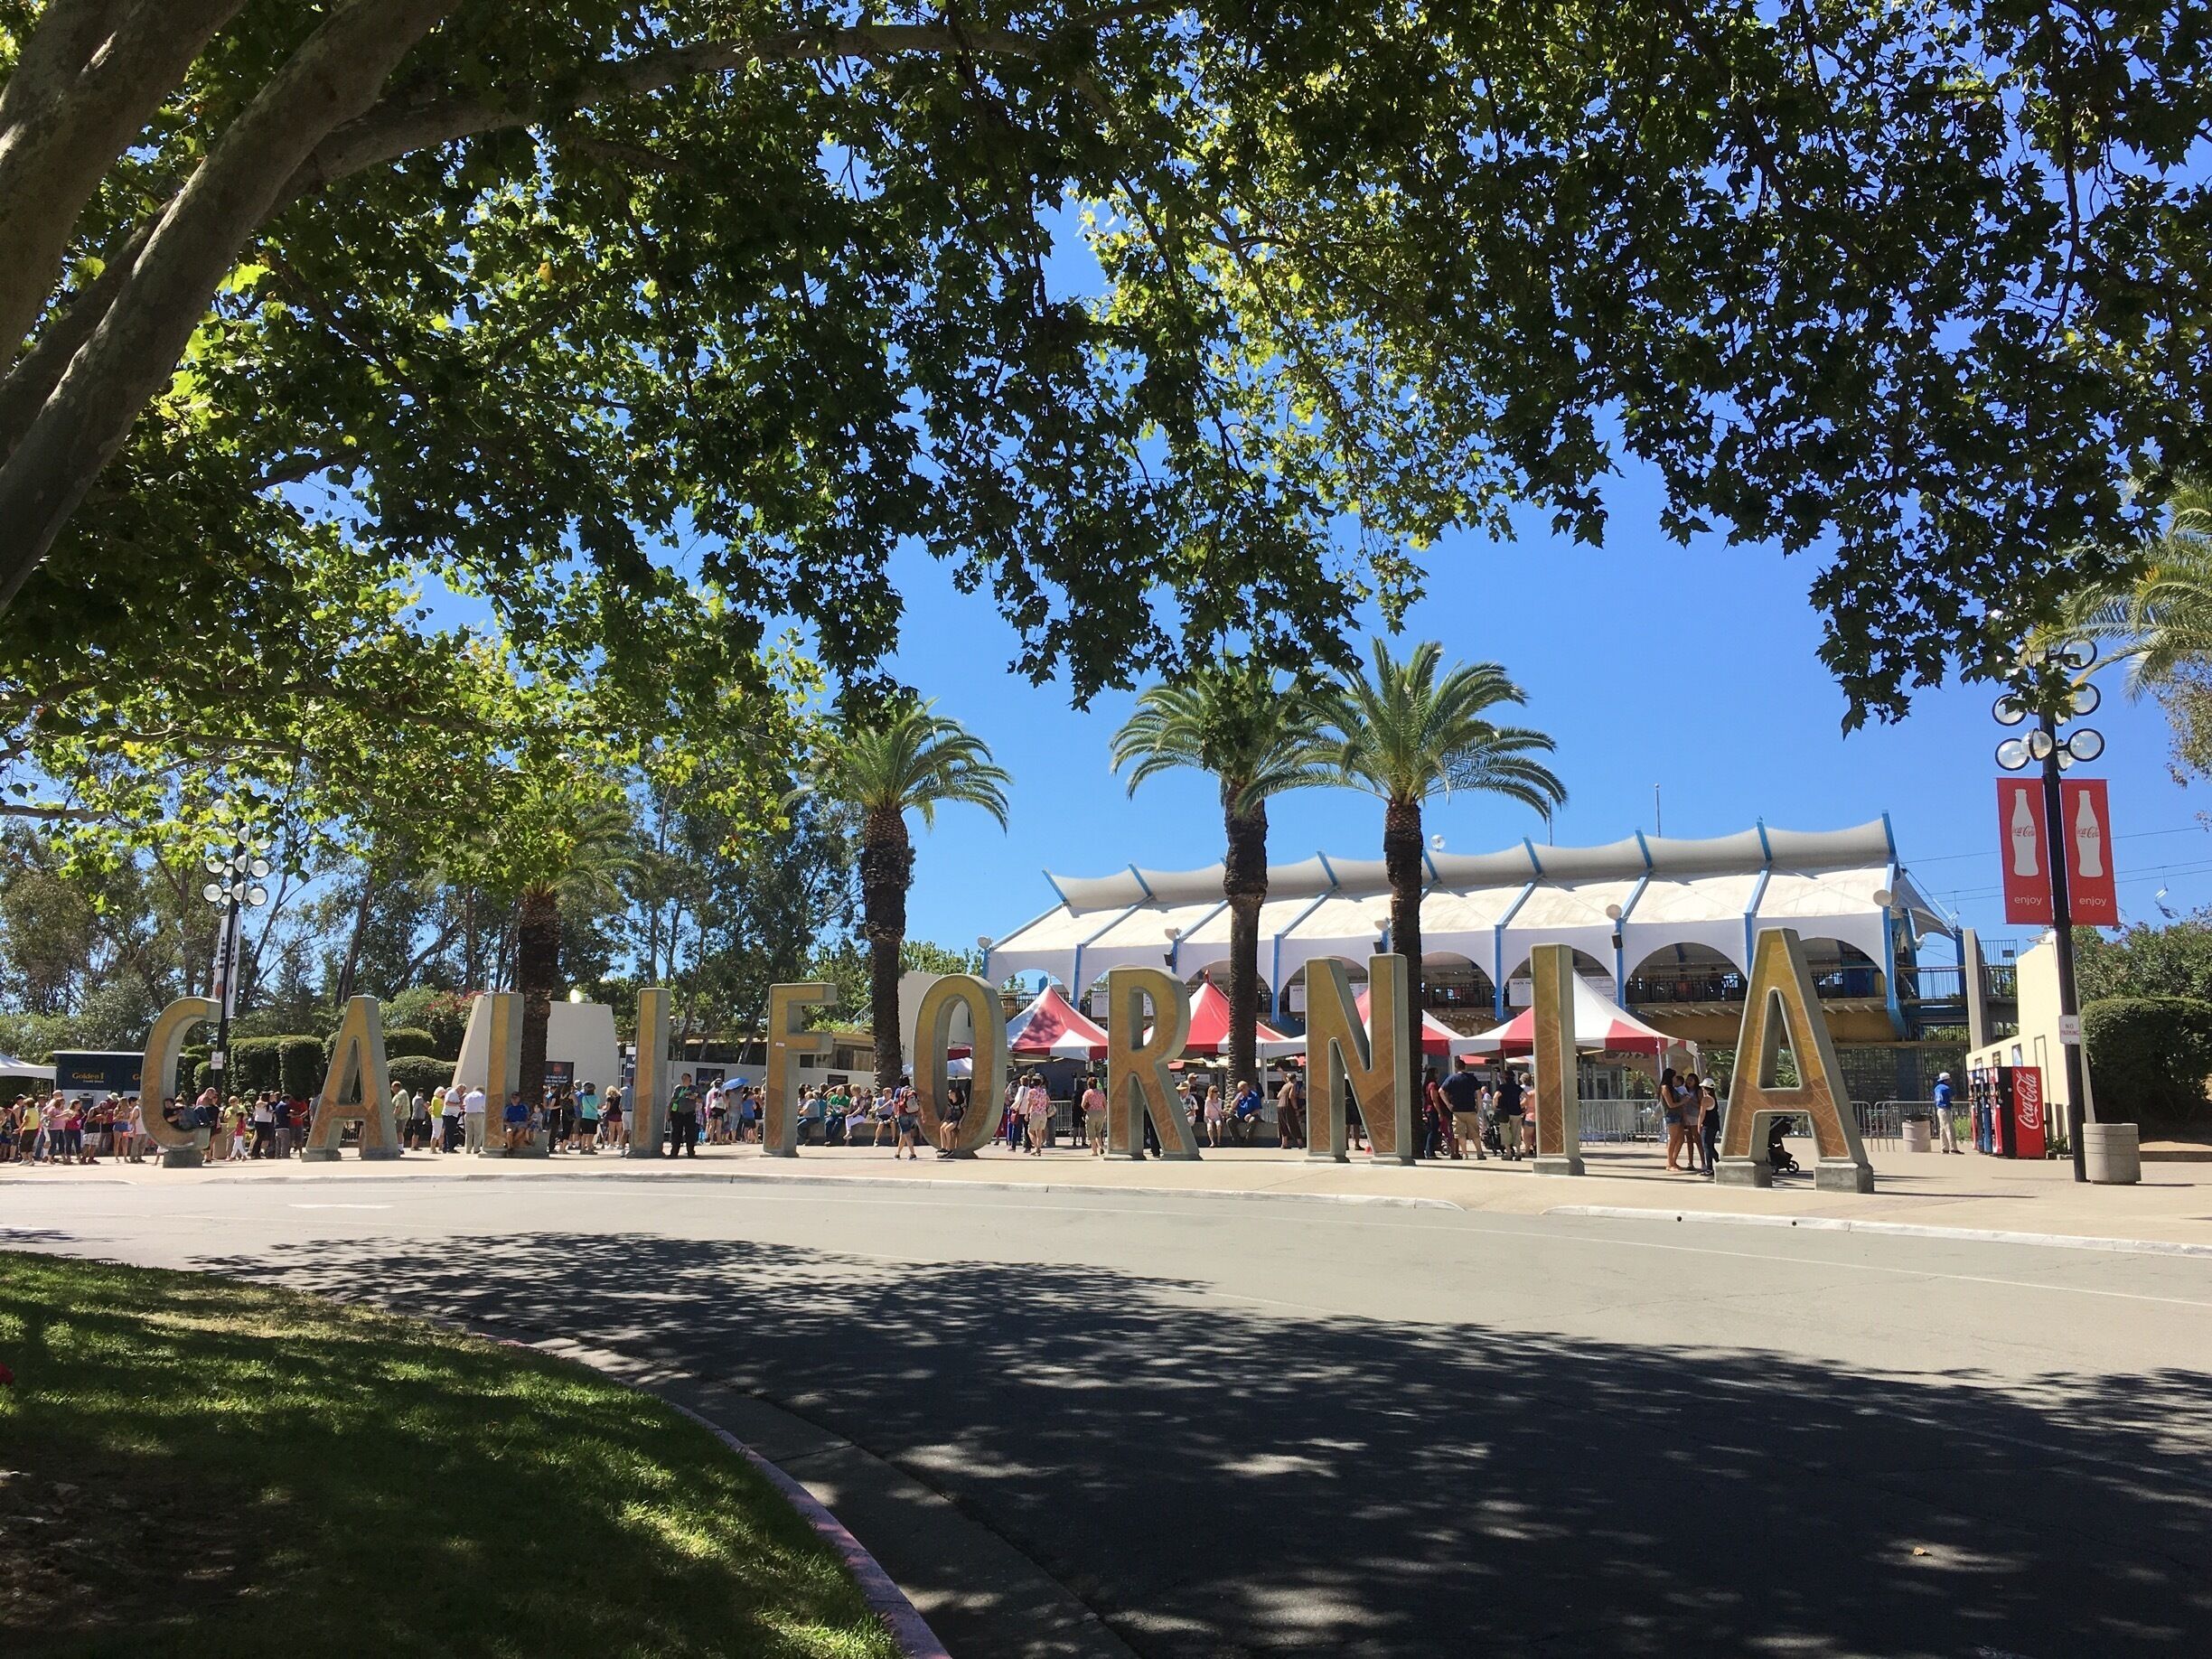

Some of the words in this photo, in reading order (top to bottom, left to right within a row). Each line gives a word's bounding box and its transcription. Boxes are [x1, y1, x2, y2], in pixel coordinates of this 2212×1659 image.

[2014, 895, 2042, 905] enjoy
[2079, 896, 2107, 906] enjoy
[141, 927, 1873, 1194] CALIFORNIA
[2016, 1070, 2039, 1129] Coca-Cola
